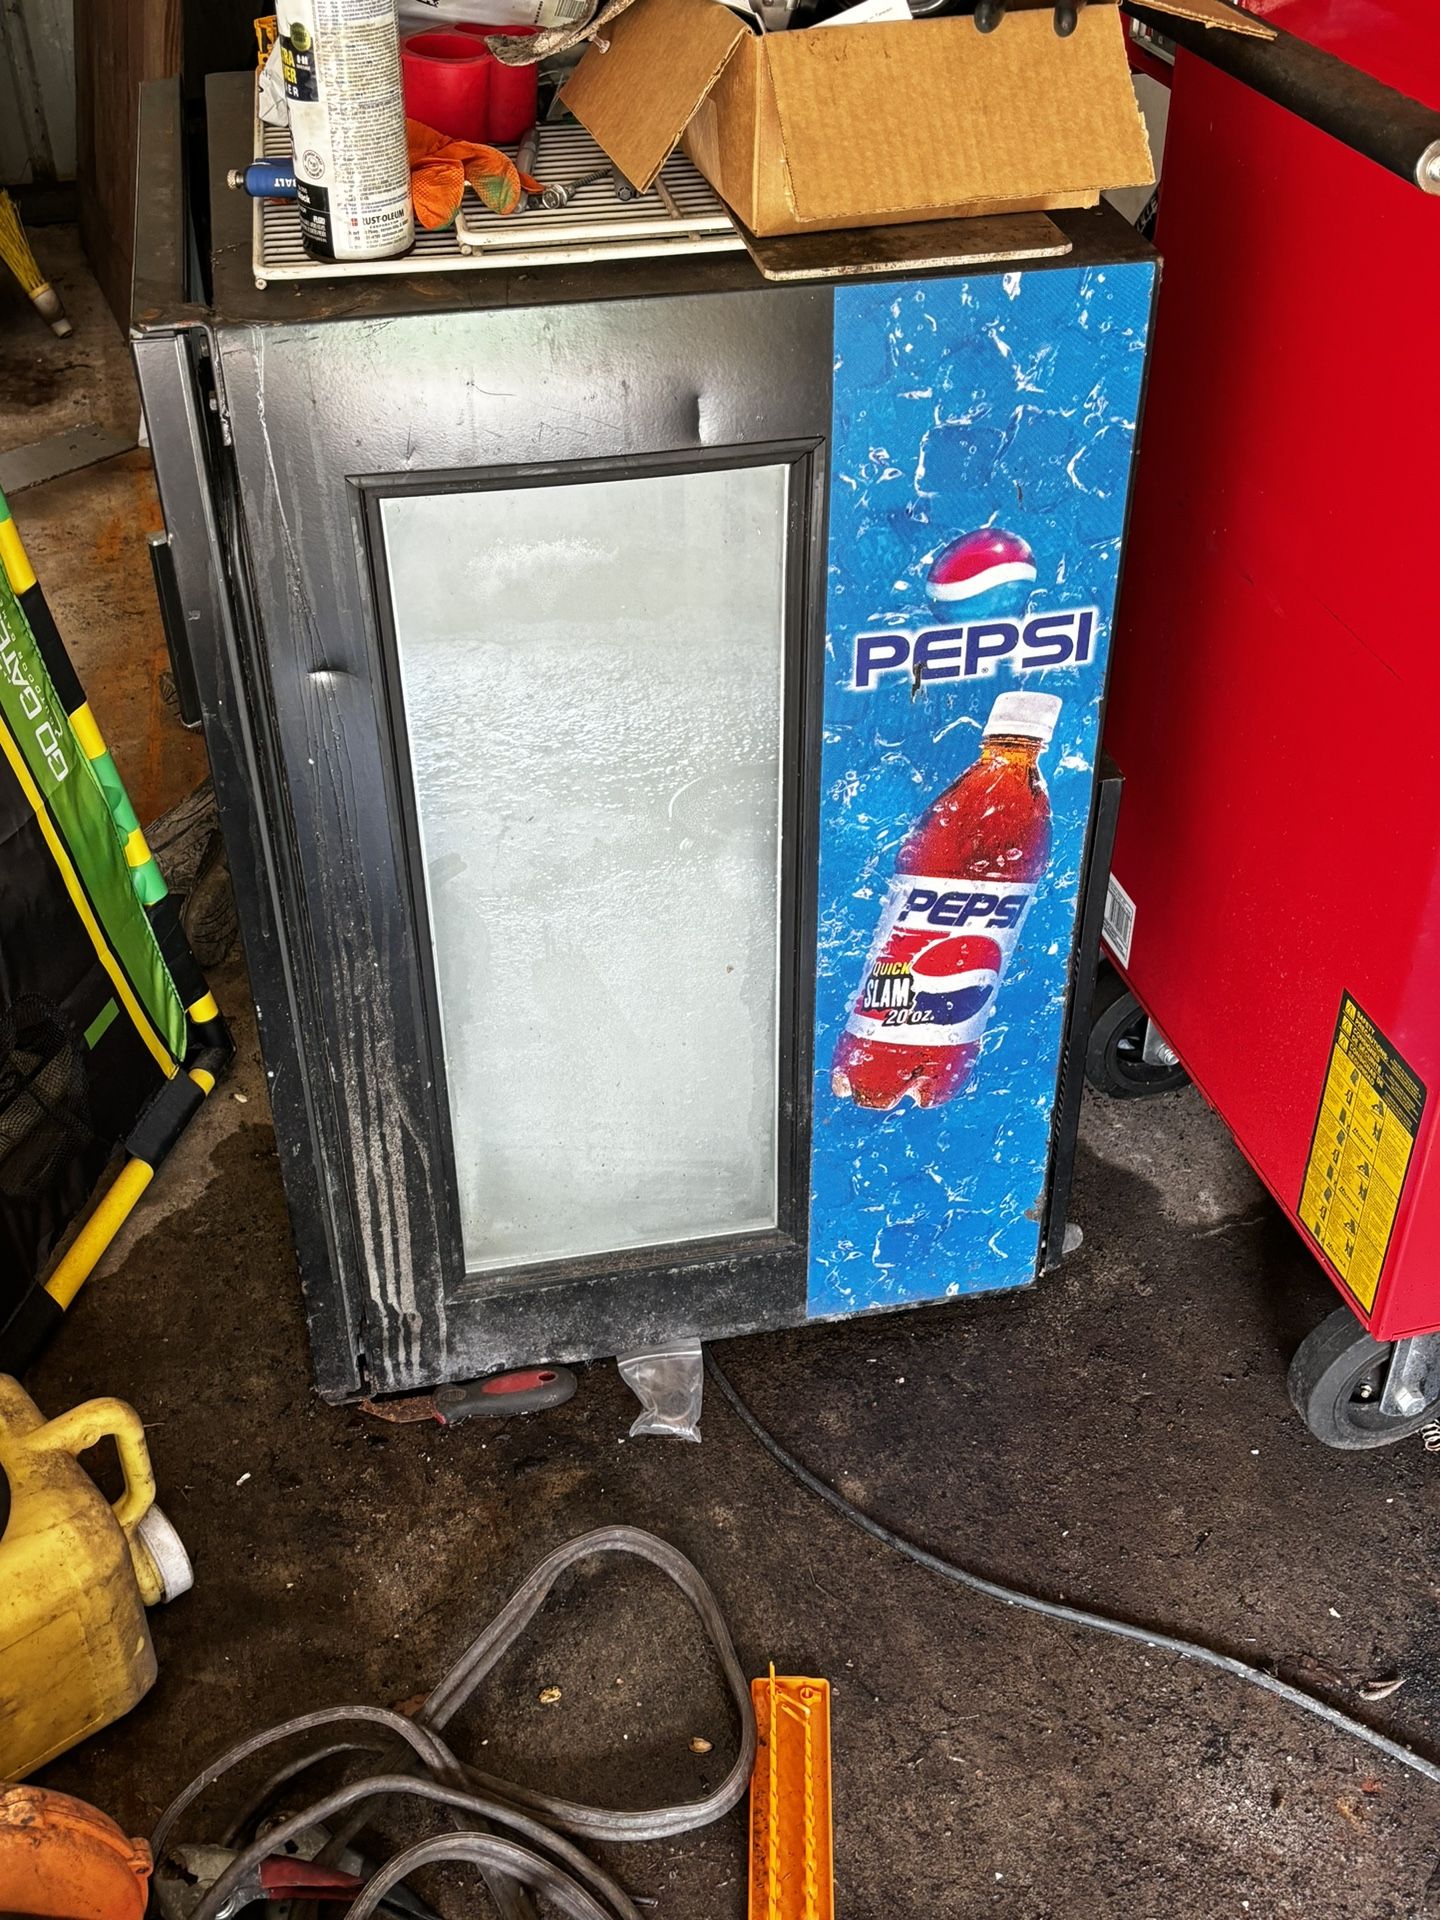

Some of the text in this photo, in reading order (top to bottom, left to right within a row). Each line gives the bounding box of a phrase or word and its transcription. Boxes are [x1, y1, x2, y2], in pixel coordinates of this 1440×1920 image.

[855, 611, 1093, 687] PEPSI
[0, 619, 69, 782] GO GATE
[872, 961, 912, 976] QUICK
[864, 977, 911, 1009] SLAM
[885, 1009, 935, 1025] 20 oz.
[1356, 1010, 1375, 1035] SAFETY
